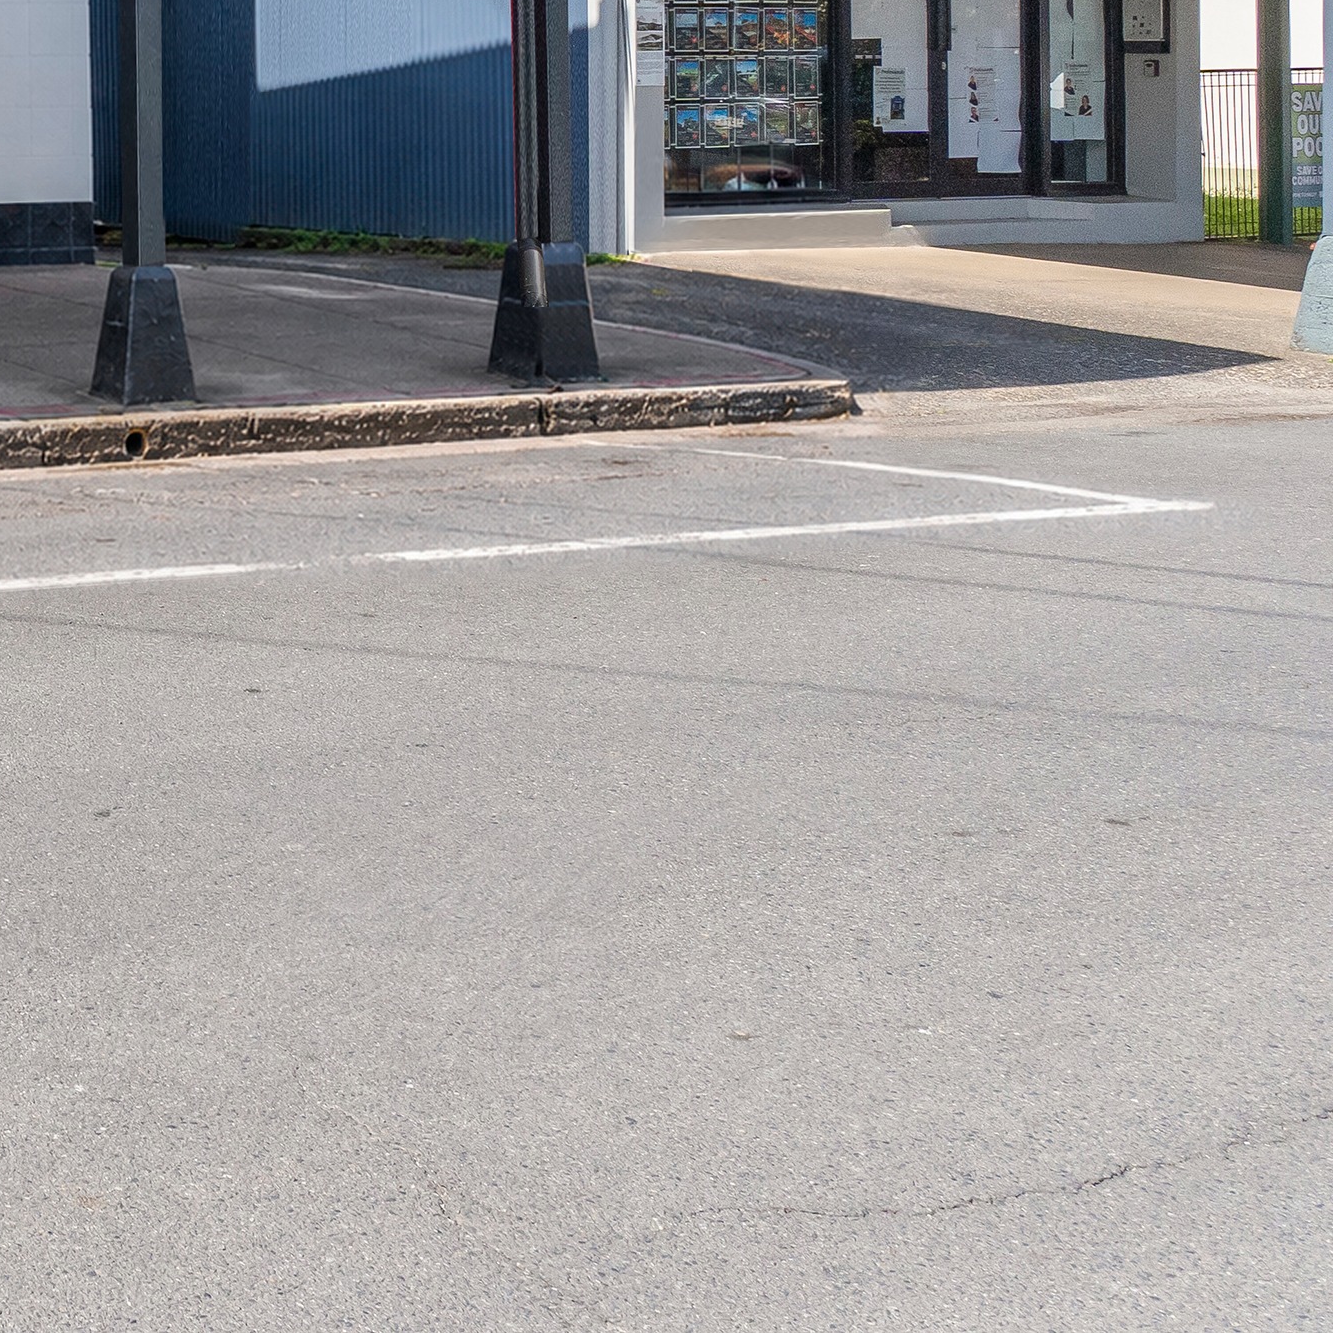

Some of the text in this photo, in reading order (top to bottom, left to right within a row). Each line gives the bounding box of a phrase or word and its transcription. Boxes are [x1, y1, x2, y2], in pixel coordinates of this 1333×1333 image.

[1291, 91, 1323, 113] SAV
[1297, 114, 1323, 135] OU
[1292, 176, 1322, 185] COMMU
